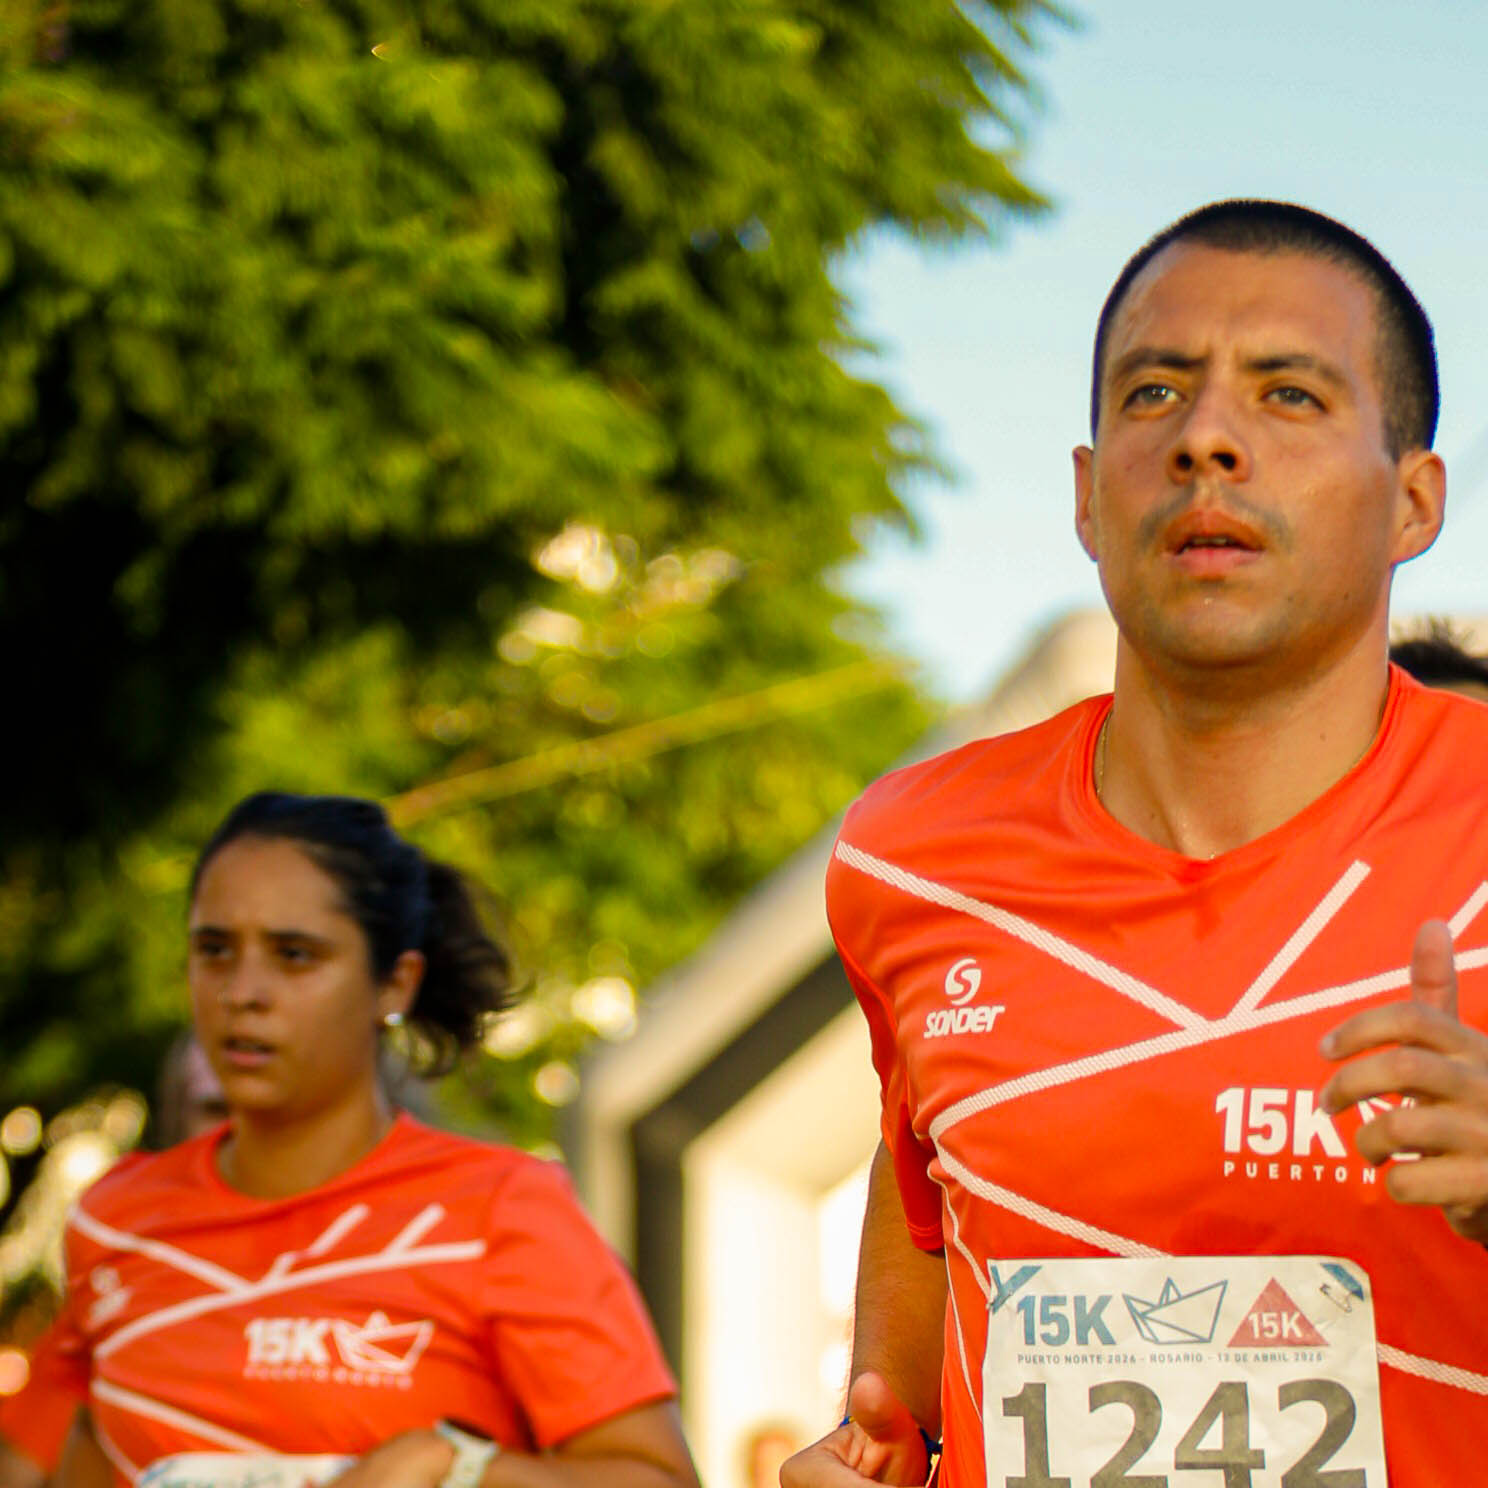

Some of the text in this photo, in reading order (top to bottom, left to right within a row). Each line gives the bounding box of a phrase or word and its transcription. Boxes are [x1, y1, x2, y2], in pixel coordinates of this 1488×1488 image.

[1215, 1087, 1347, 1158] 15K
[1223, 1160, 1348, 1183] PUERTO
[1016, 1295, 1117, 1347] 15K
[1248, 1311, 1304, 1339] 15K
[244, 1317, 330, 1366] 15K
[1017, 1353, 1061, 1365] PUERTO
[1064, 1353, 1102, 1365] NORTE
[1149, 1352, 1203, 1364] ROSARIO
[1234, 1351, 1248, 1363] DE
[1253, 1351, 1289, 1363] ABRIL
